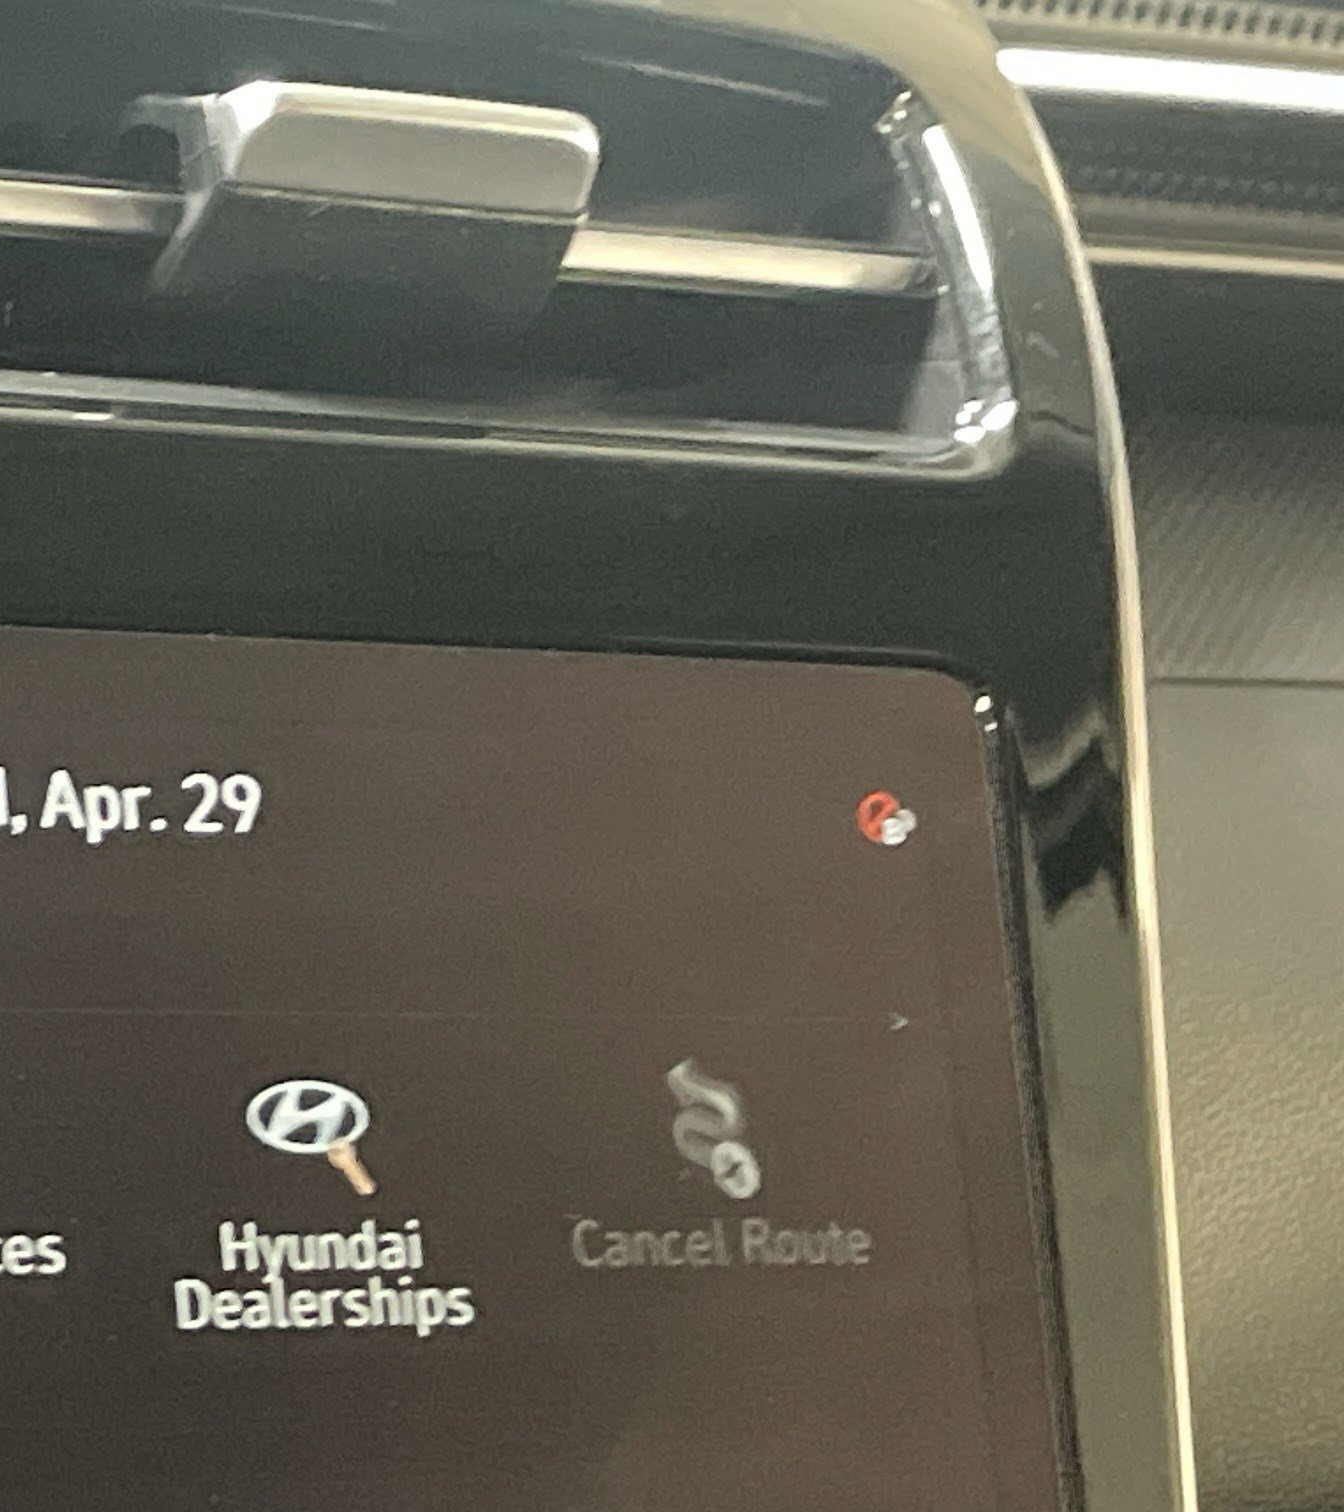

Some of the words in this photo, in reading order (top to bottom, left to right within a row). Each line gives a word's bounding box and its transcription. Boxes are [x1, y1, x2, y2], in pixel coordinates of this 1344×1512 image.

[38, 769, 169, 845] Apr.
[180, 772, 263, 834] 29
[218, 1218, 424, 1288] Hyundai
[571, 1217, 732, 1269] Cancel
[740, 1216, 873, 1267] Route
[173, 1271, 476, 1338] Dealerships
